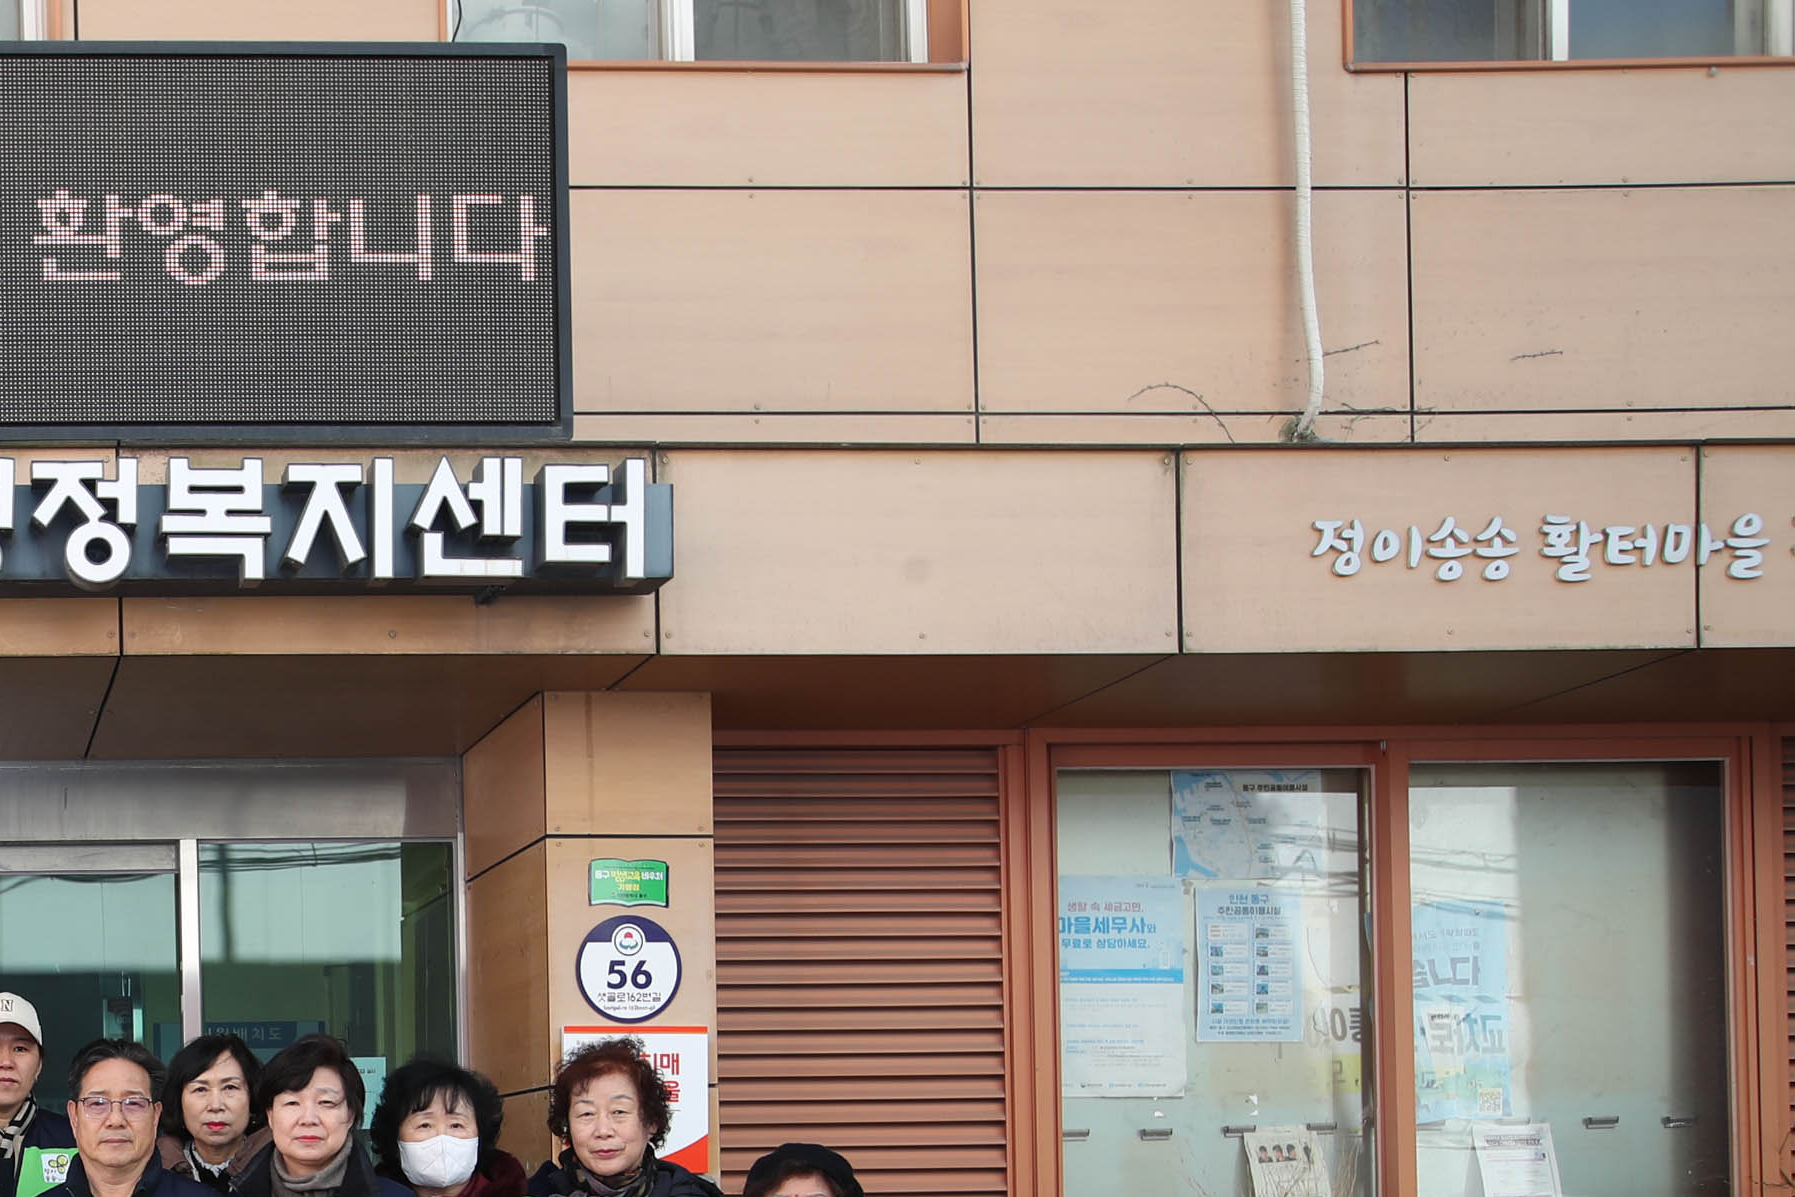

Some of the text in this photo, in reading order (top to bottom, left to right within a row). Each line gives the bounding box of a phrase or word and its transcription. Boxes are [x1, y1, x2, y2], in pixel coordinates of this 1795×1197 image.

[33, 189, 551, 285] 환영합니다
[1311, 516, 1520, 582] 정이송송
[607, 960, 652, 989] 56
[1, 999, 13, 1011] N
